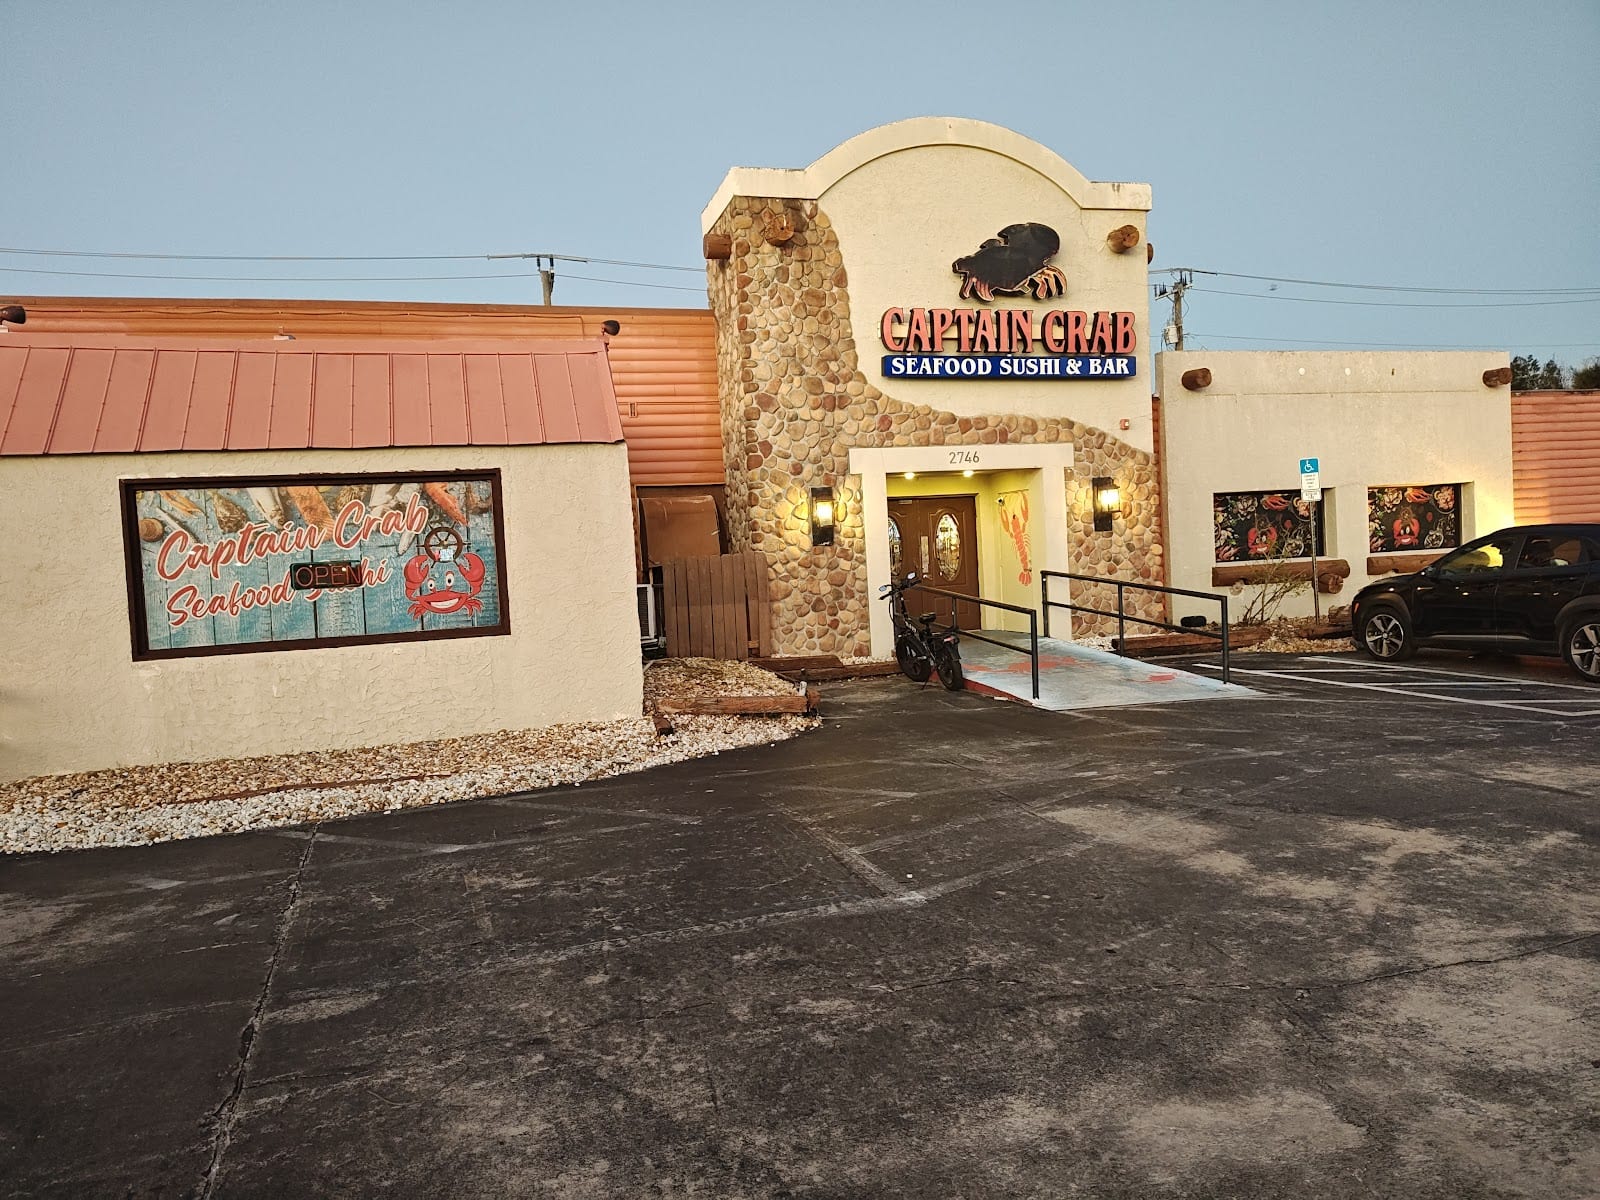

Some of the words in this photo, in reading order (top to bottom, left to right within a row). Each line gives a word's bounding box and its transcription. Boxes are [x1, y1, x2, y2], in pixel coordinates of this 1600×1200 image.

[881, 307, 1034, 353] CAPTAIN
[1042, 309, 1136, 354] CRAB
[891, 357, 992, 375] SEAFOOD
[999, 357, 1060, 375] SUSHI
[1066, 358, 1083, 375] &
[1089, 358, 1130, 375] BAR
[949, 451, 980, 465] 2746
[157, 520, 326, 582] Captain
[332, 492, 429, 549] Crab
[295, 565, 362, 587] OPEN
[167, 569, 295, 627] Seafood
